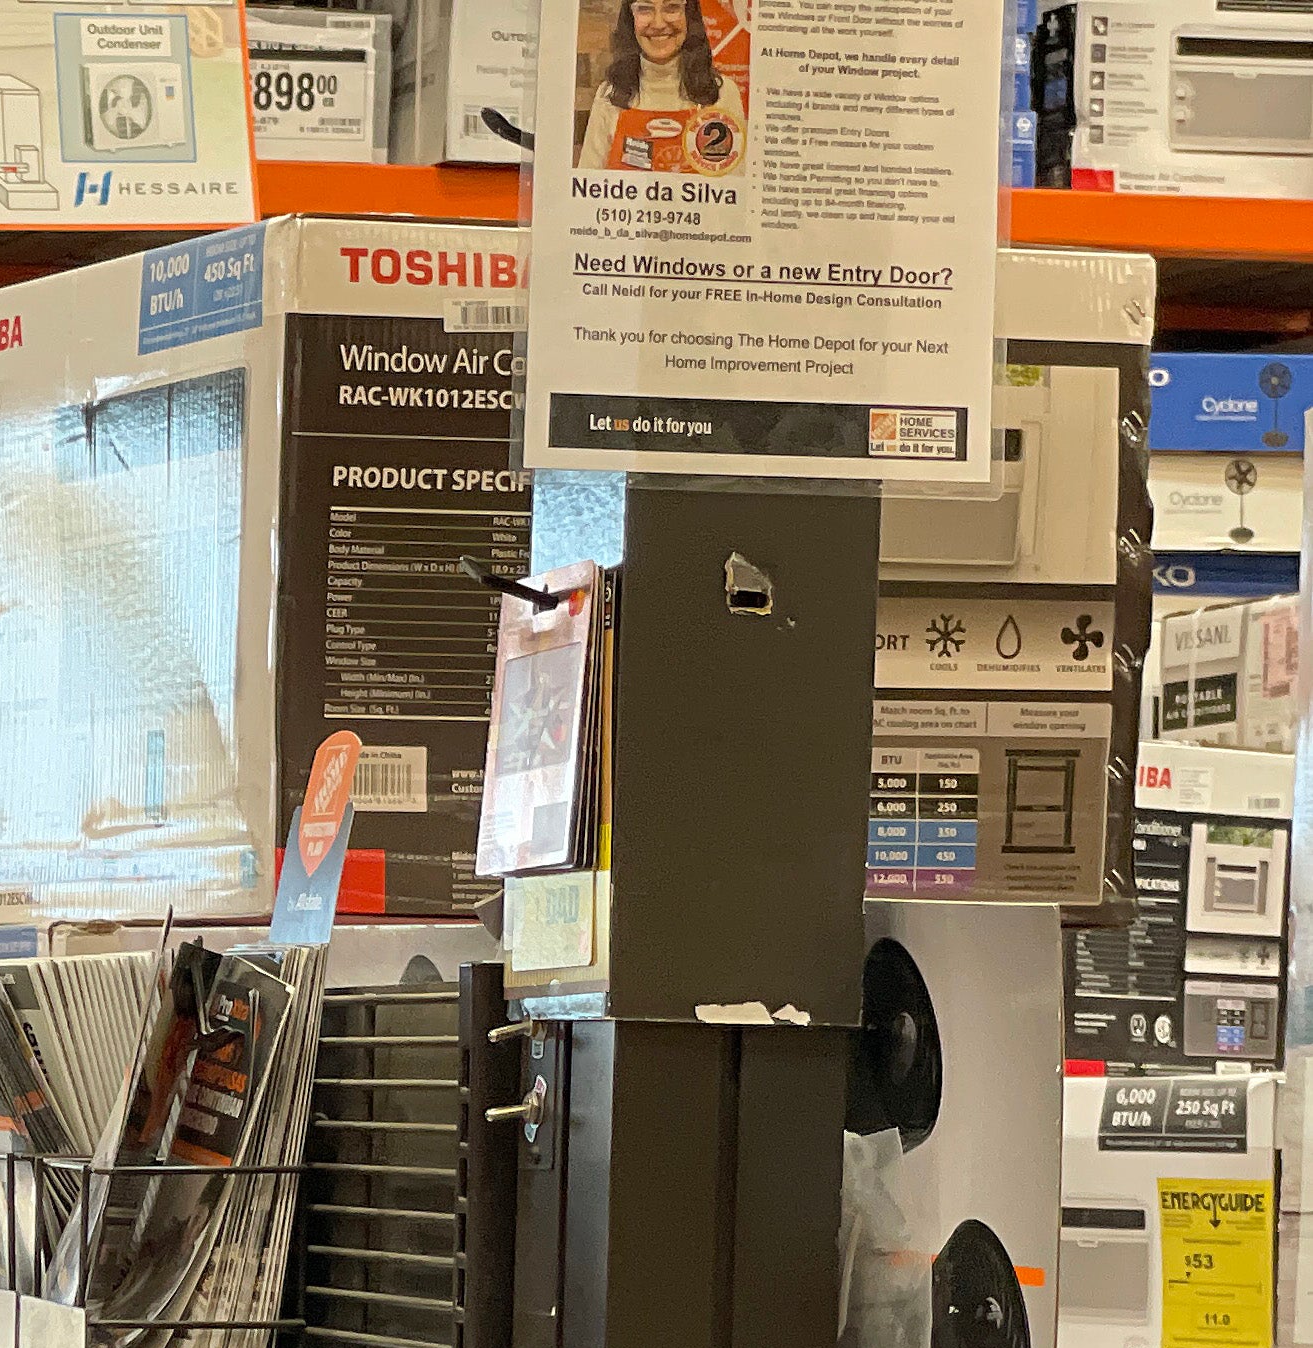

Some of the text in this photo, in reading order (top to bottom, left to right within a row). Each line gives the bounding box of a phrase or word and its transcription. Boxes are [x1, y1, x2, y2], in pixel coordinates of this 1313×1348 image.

[87, 23, 163, 35] Outdoor Unit
[97, 38, 161, 49] Condenser
[119, 182, 238, 195] HESSAIRE
[572, 178, 737, 204] Neide da Silva
[596, 208, 700, 225] (510) 219-9748
[149, 254, 254, 283] 10,000 450 Sq Ft
[574, 253, 953, 286] Need Windows or a new Entry Door?
[149, 290, 184, 316] BTU/h
[583, 283, 607, 296] Call
[649, 286, 668, 298] for
[671, 289, 701, 302] your
[706, 289, 742, 301] FREE
[747, 290, 802, 304] In-Home
[806, 292, 852, 308] Design
[856, 294, 941, 308] Consultation
[574, 326, 948, 355] Thank you for choosing The Home Depot for your Next
[340, 344, 447, 373] Window
[453, 349, 489, 375] Air
[666, 354, 853, 375] Home Improvement Project
[1202, 396, 1258, 414] Cyclone
[590, 414, 712, 437] Let us do it for you
[899, 418, 932, 427] HOME
[899, 428, 955, 438] SERVICES
[333, 466, 447, 489] PRODUCT
[330, 512, 356, 522] Model
[329, 528, 517, 543] Color White
[328, 560, 409, 572] Product Dimensions
[326, 640, 355, 650] Control
[1116, 1088, 1235, 1118] 6,000 250 Sq Ft
[1112, 1111, 1151, 1127] BTU/h
[1161, 1191, 1265, 1214] ENERGYGUIDE
